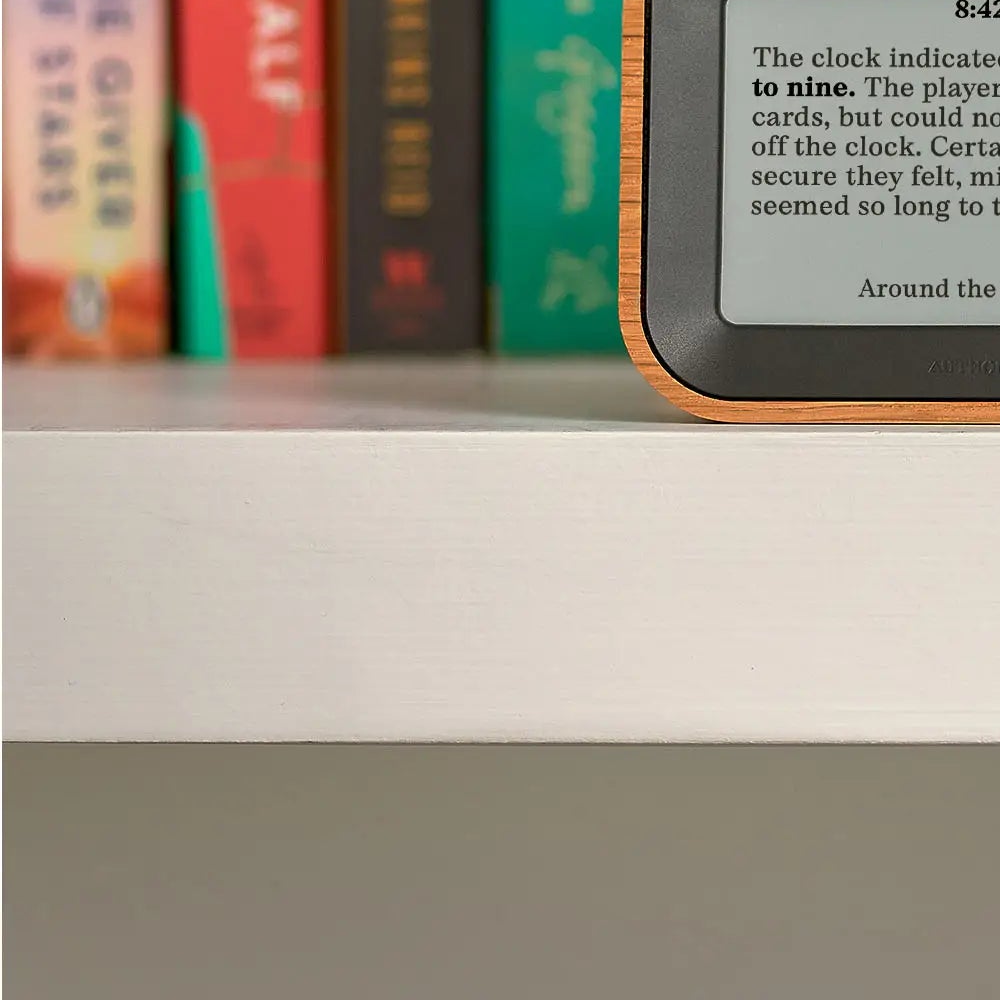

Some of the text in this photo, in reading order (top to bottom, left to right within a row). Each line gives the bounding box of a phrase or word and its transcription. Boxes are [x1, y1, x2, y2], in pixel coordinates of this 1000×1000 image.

[752, 46, 804, 68] The
[811, 46, 882, 69] clock
[751, 78, 779, 97] to
[786, 75, 856, 98] nine.
[863, 76, 914, 98] The
[32, 46, 77, 212] STARS
[751, 105, 830, 131] cards,
[838, 105, 883, 128] but
[890, 105, 964, 128] could
[92, 58, 134, 228] GIVER
[752, 135, 789, 157] off
[795, 135, 836, 157] the
[845, 135, 922, 157] clock.
[751, 170, 837, 186] secure
[845, 164, 904, 192] they
[911, 164, 962, 191] felt,
[750, 194, 850, 216] seemed
[858, 200, 886, 216] so
[893, 194, 951, 223] long
[958, 197, 984, 217] to
[857, 277, 950, 299] Around
[956, 278, 997, 299] the
